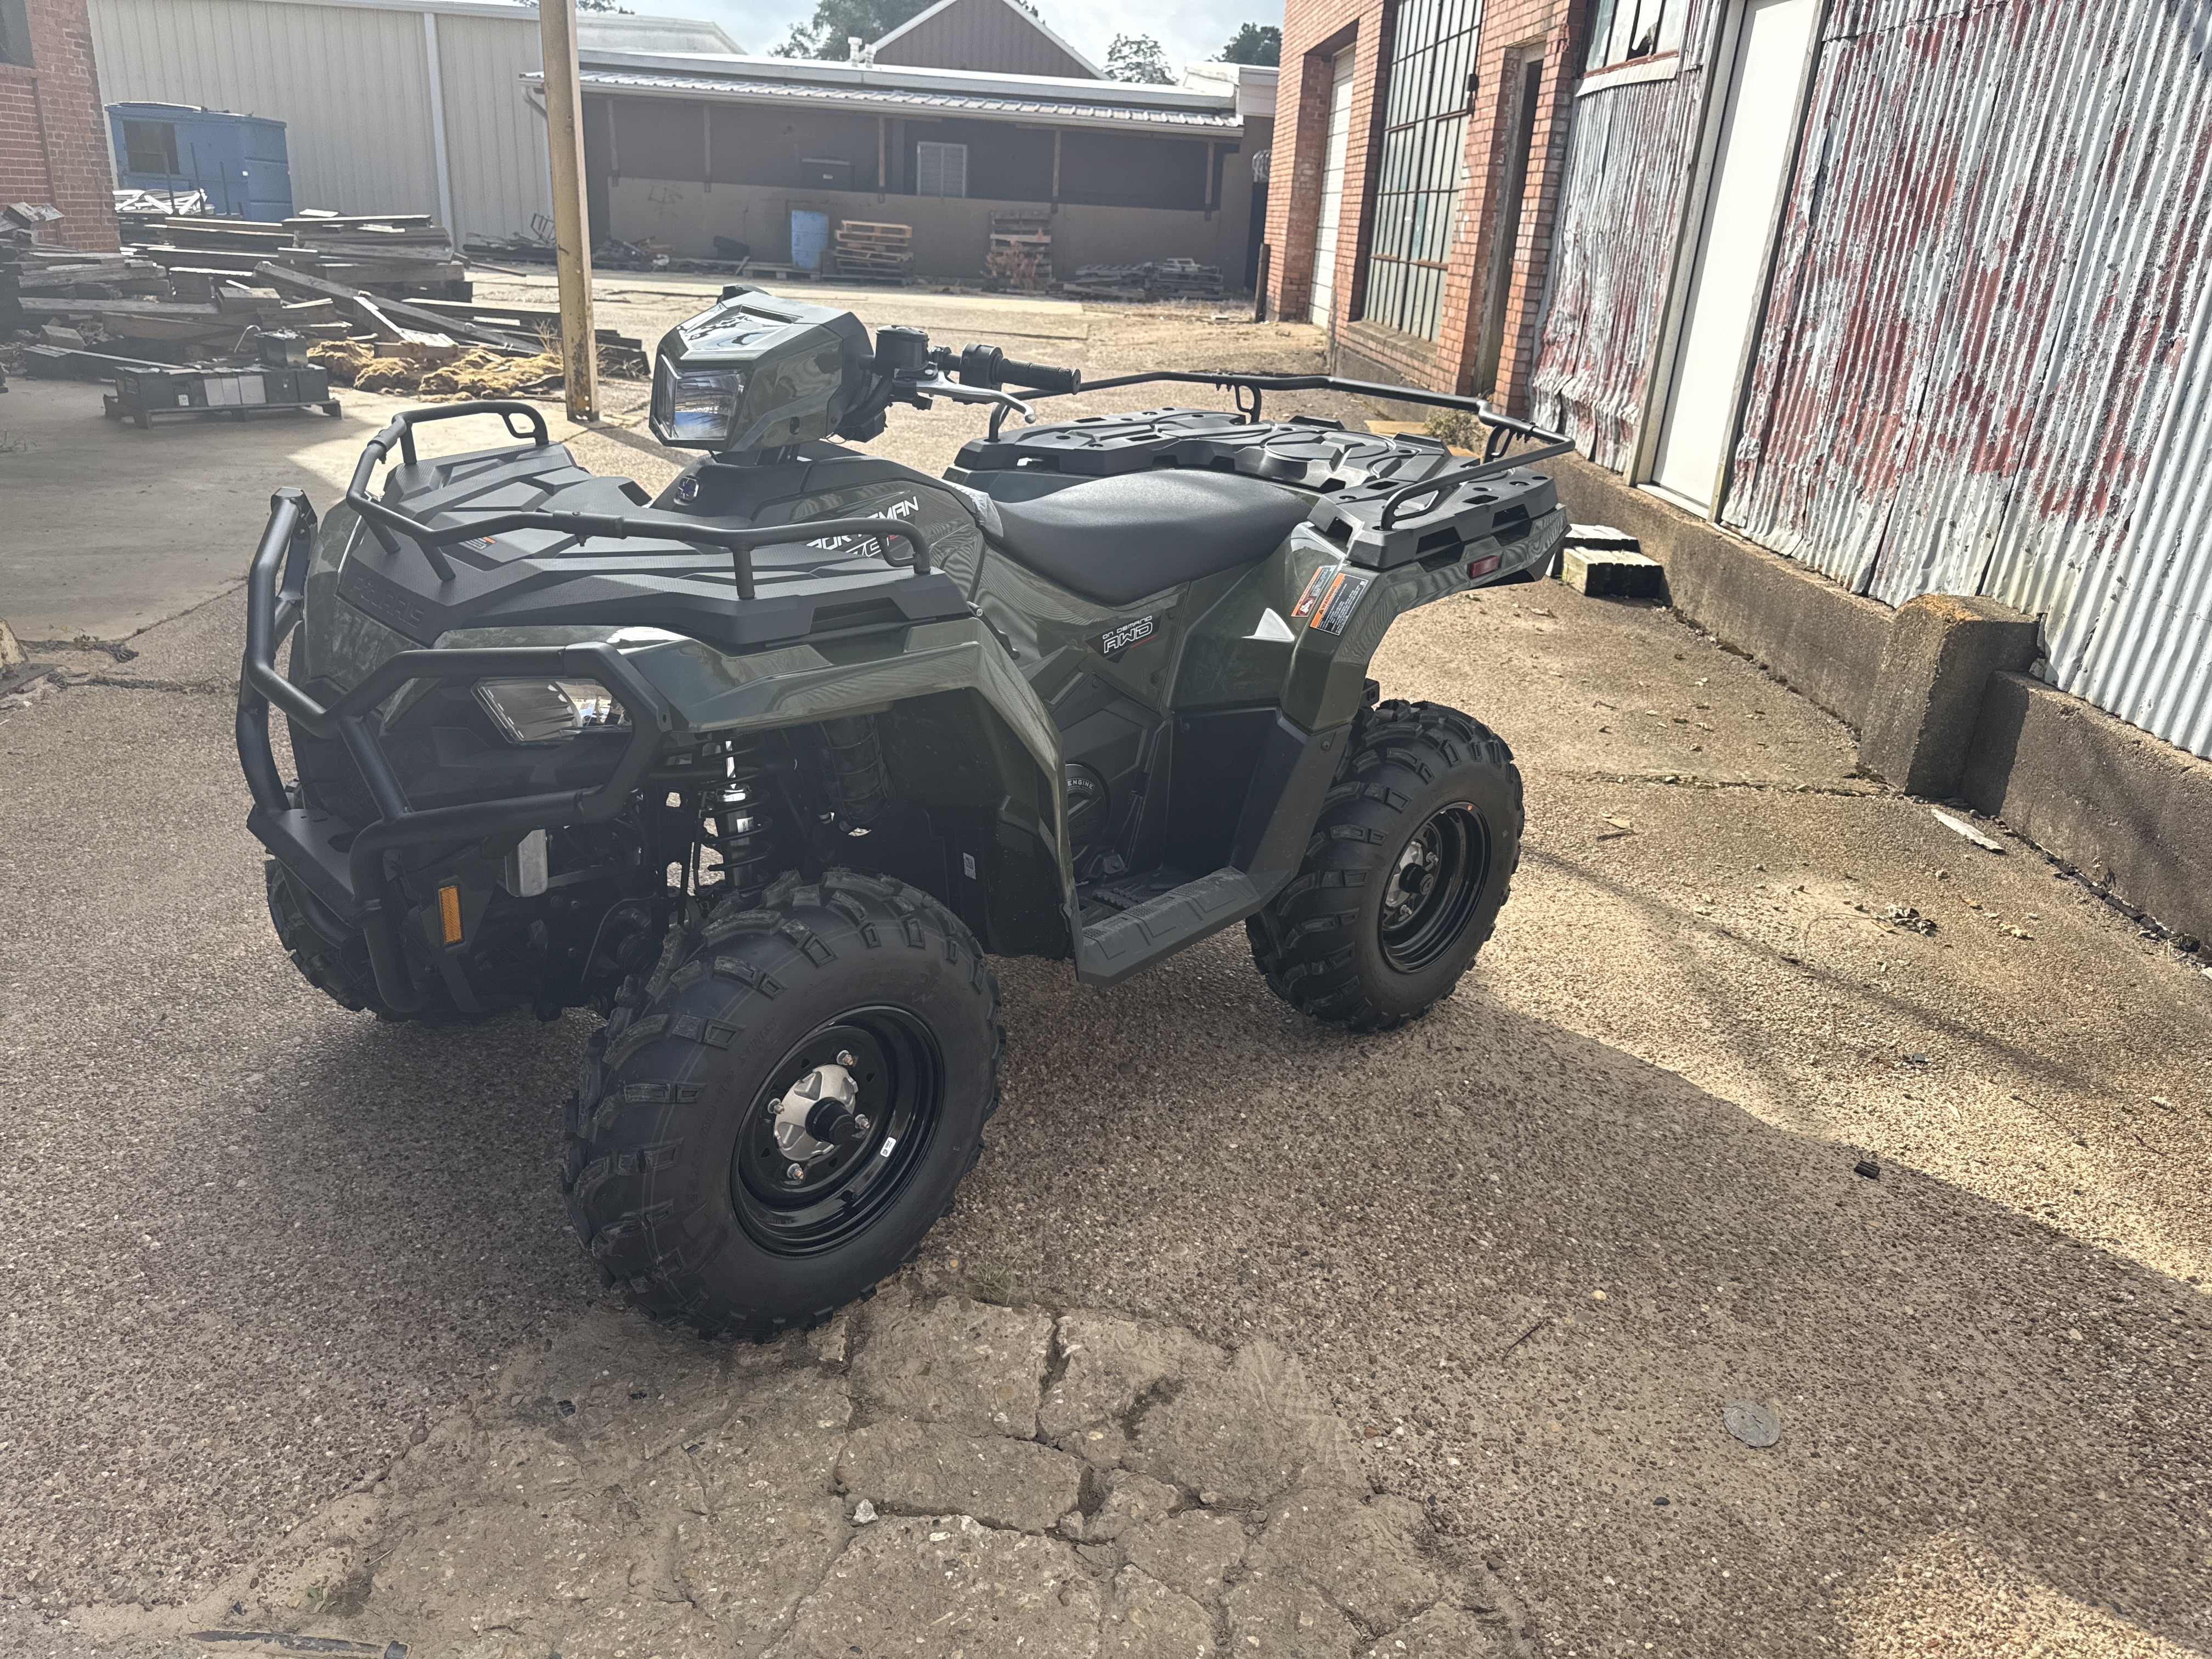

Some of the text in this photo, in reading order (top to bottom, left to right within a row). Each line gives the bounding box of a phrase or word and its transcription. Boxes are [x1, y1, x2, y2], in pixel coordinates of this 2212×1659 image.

[349, 576, 426, 629] POLARIS
[1102, 615, 1153, 640] ON DEMAND
[1104, 622, 1153, 654] AWD
[1067, 779, 1093, 790] ENGINE
